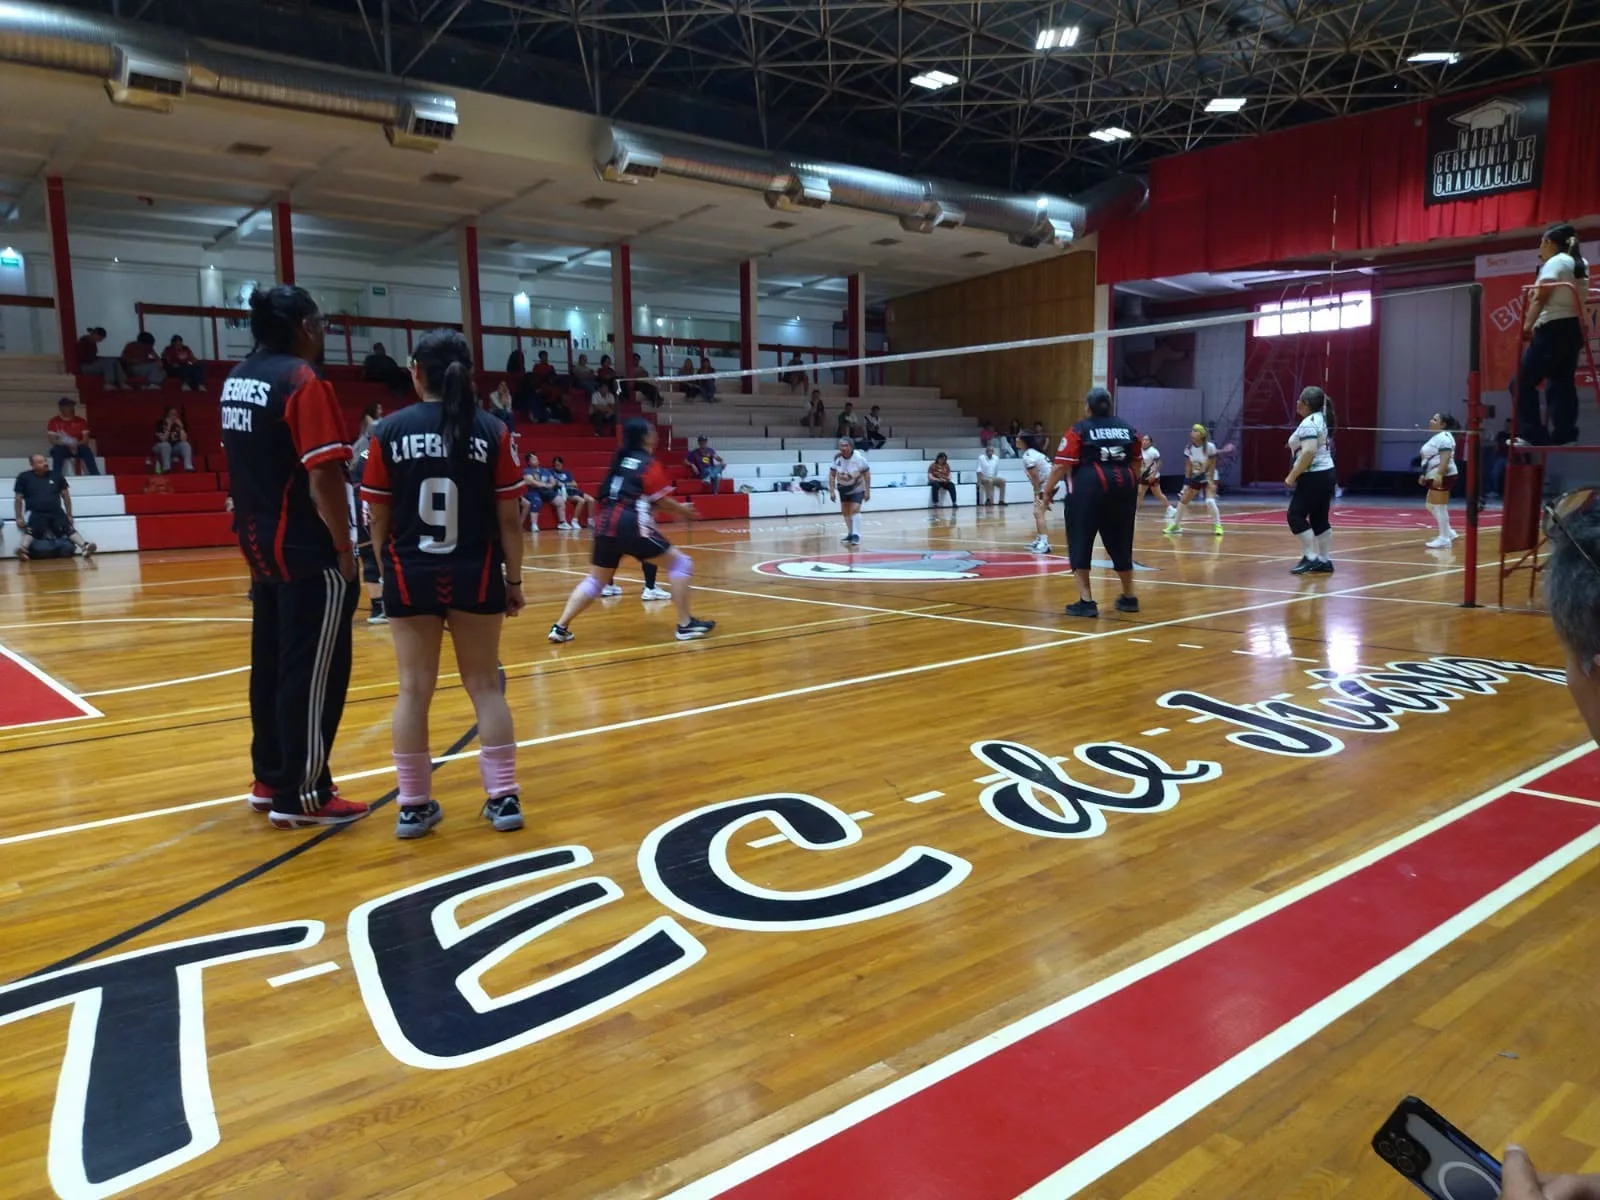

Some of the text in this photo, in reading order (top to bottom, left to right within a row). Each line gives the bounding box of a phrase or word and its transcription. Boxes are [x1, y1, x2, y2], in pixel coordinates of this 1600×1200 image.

[1436, 139, 1532, 174] CEREMONIA DE
[1089, 427, 1130, 440] LIEBRES
[418, 477, 459, 554] 9
[0, 792, 972, 1200] TEC
[969, 740, 1223, 839] de
